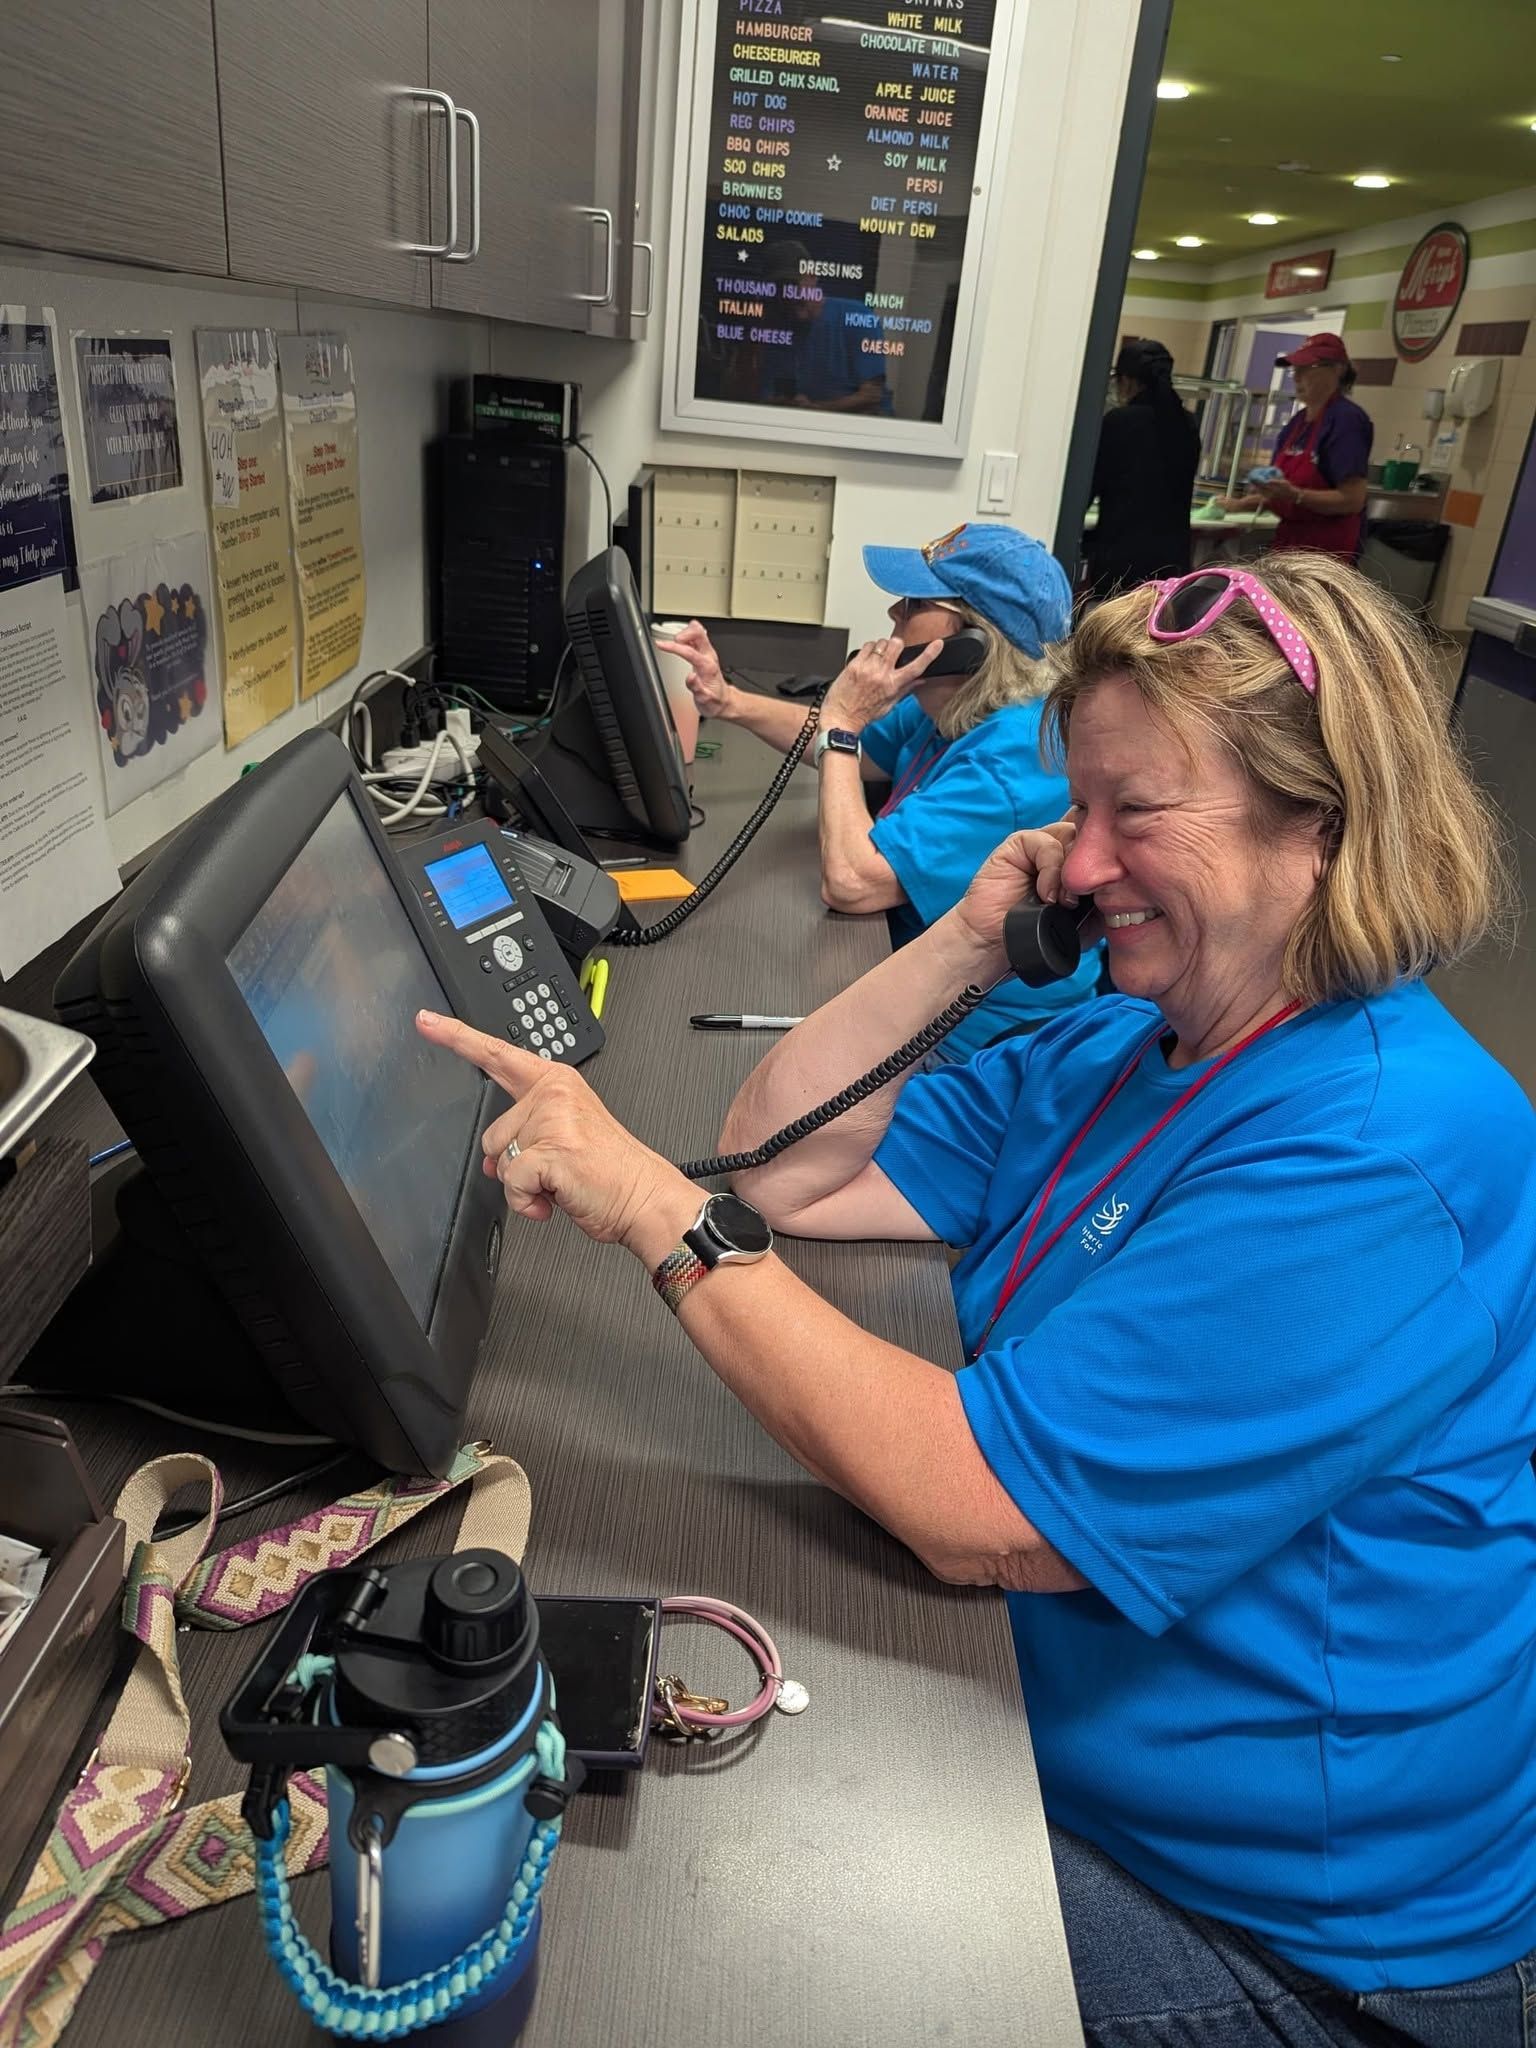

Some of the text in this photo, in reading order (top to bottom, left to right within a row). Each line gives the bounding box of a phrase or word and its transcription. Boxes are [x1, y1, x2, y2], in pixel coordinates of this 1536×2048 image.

[735, 20, 813, 42] HAMBURGER
[887, 12, 962, 34] WHITE MILK
[733, 44, 821, 67] CHEESEBURGER
[860, 34, 960, 57] CHOCOLATE MILK
[730, 68, 774, 86] GRILLED
[778, 72, 805, 89] CHIX
[912, 63, 959, 81] WATER
[733, 91, 787, 110] HOT DOG
[876, 83, 956, 104] APPLE JUICE
[730, 114, 795, 134] REG CHIPS
[865, 105, 953, 127] ORANGE JUICE
[726, 136, 790, 157] BBQ CHIPS
[867, 129, 950, 149] ALMOND MILK
[752, 161, 786, 179] CHIPS
[884, 152, 947, 173] SOY MILK
[722, 181, 783, 201] BROWNIES
[906, 178, 943, 195] PEPSI
[719, 203, 823, 228] CHOC CHIP COOKIE
[871, 196, 938, 216] DIET PEPSI
[716, 225, 764, 243] SALADS
[860, 218, 936, 239] MOUNT DEW
[799, 260, 863, 280] DRESSINGS
[716, 278, 823, 302] THOUSAND ISLAND
[719, 300, 763, 318] ITALIAN
[865, 292, 904, 310] RANCH
[845, 312, 932, 334] HONEY MUSTARD
[717, 325, 793, 346] BLUE CHEESE
[861, 339, 905, 356] CAESAR
[9, 363, 40, 393] PHONE
